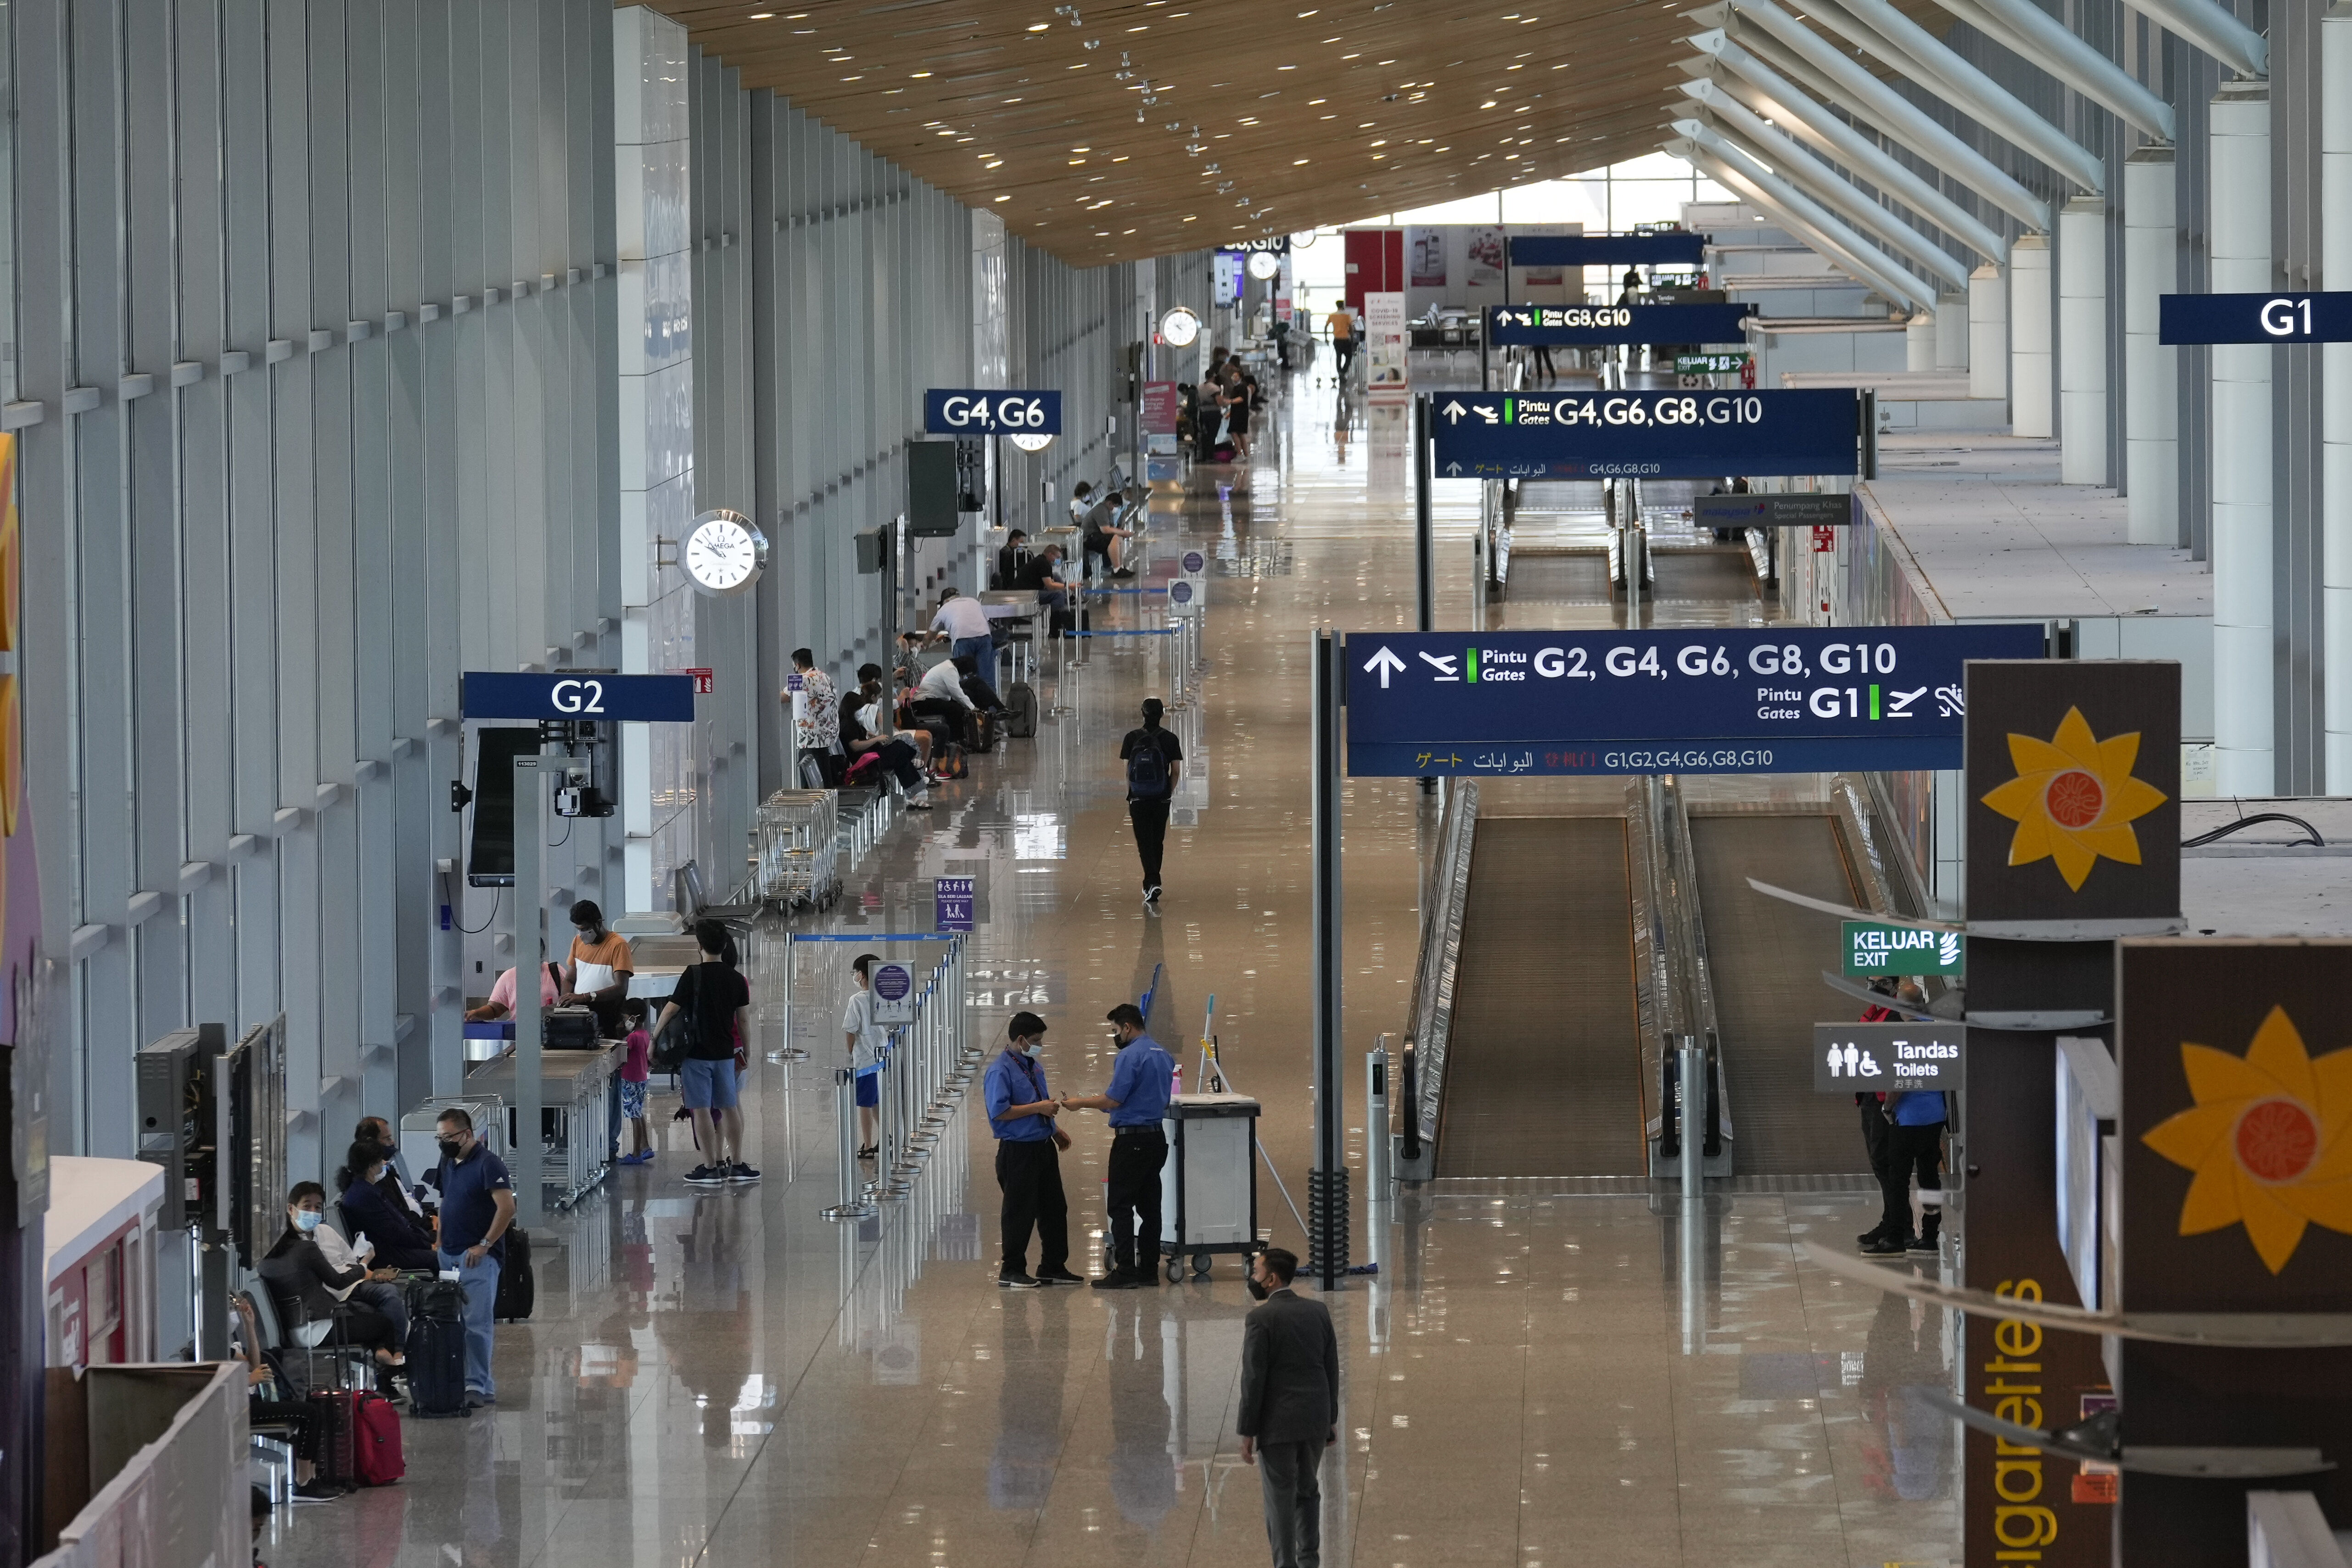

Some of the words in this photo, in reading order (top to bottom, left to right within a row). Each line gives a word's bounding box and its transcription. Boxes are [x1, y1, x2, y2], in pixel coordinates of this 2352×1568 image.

[1542, 309, 1562, 318] Pintu
[2261, 298, 2311, 336] G1
[1542, 318, 1562, 327] Gates
[1678, 356, 1708, 364] KELUAR
[1518, 399, 1550, 412] Pintu
[1518, 415, 1550, 425] Gates
[1774, 502, 1820, 512] Penumpang
[1822, 501, 1842, 509] Khas
[1702, 508, 1751, 520] malaysia
[1482, 650, 1527, 664] Pintu
[1820, 643, 1897, 674] G10
[1482, 669, 1525, 682] Gates
[551, 679, 605, 713] G2
[1757, 688, 1802, 702] Pintu
[1809, 688, 1858, 718] G1
[1757, 707, 1800, 720] Gates
[1416, 752, 1463, 768] ゲート
[1854, 930, 1934, 950] KELUAR
[1854, 952, 1889, 967] EXIT
[1893, 1040, 1958, 1059] Tandas
[1893, 1063, 1939, 1077] Toilets
[1894, 1079, 1923, 1089] お手洗
[1984, 1277, 2058, 1568] igarettes
